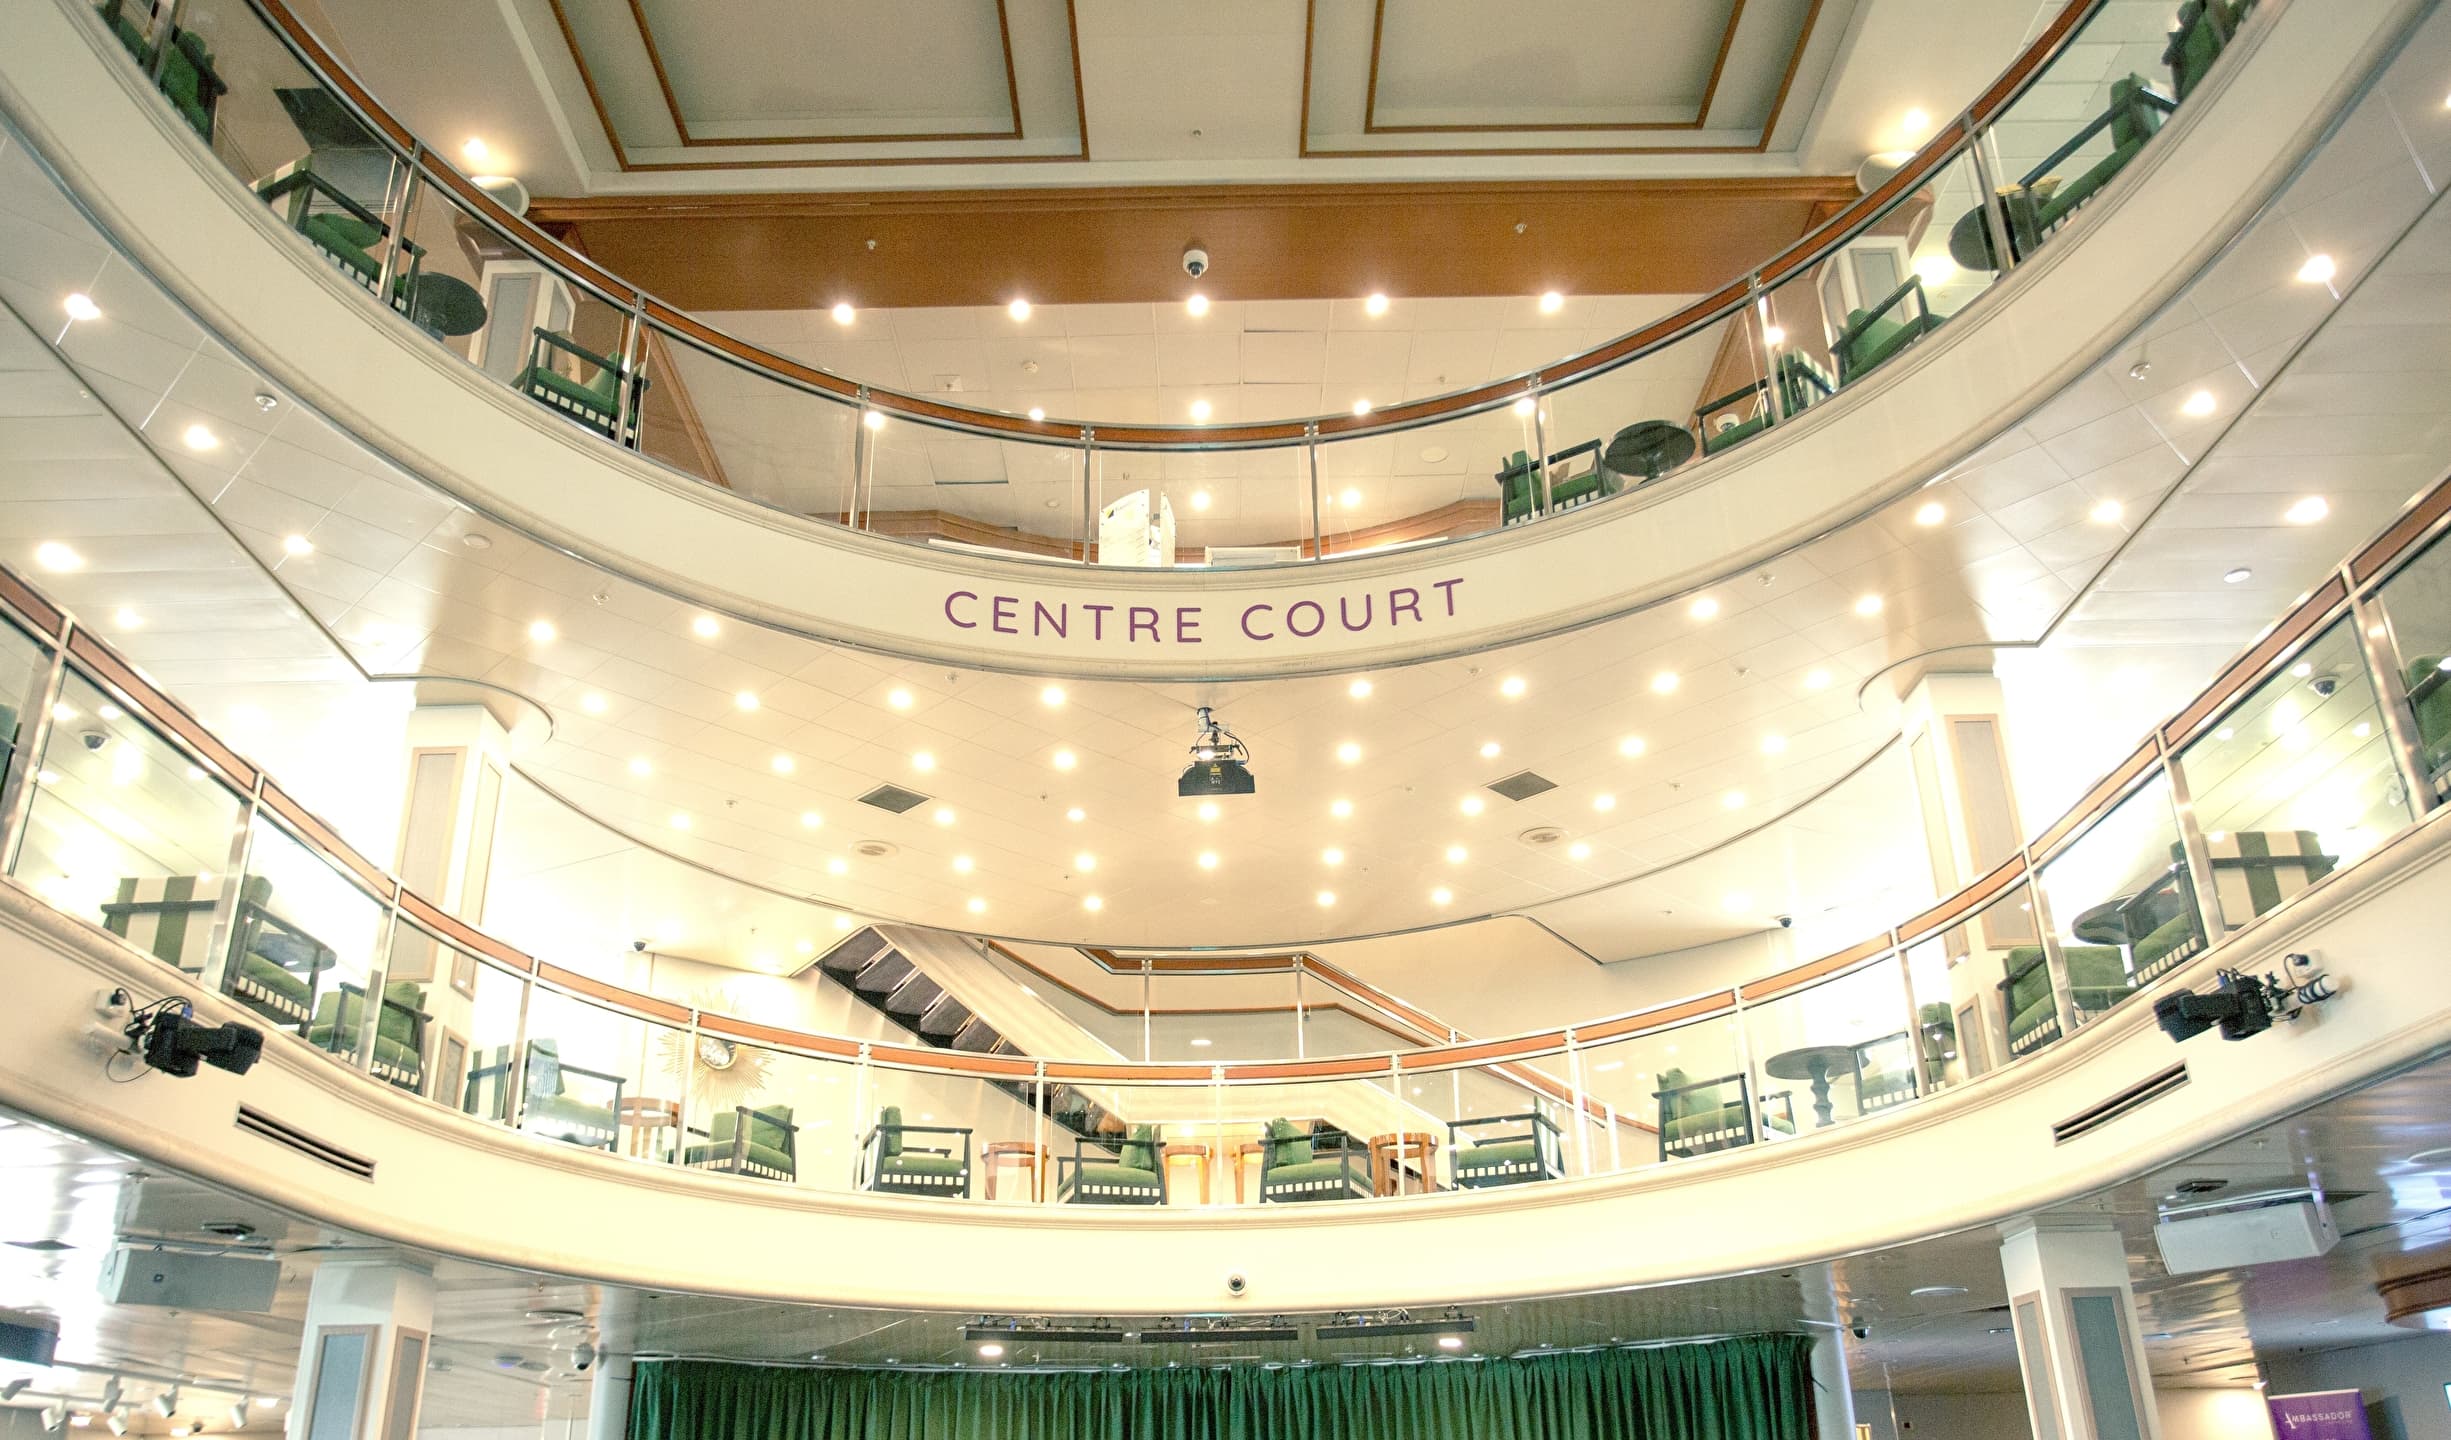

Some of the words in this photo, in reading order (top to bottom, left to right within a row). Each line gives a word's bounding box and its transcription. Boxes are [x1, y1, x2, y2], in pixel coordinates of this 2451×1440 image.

[944, 590, 1203, 643] CENTRE
[1240, 577, 1464, 641] COURT
[2284, 1410, 2352, 1429] AMBASSADOR
